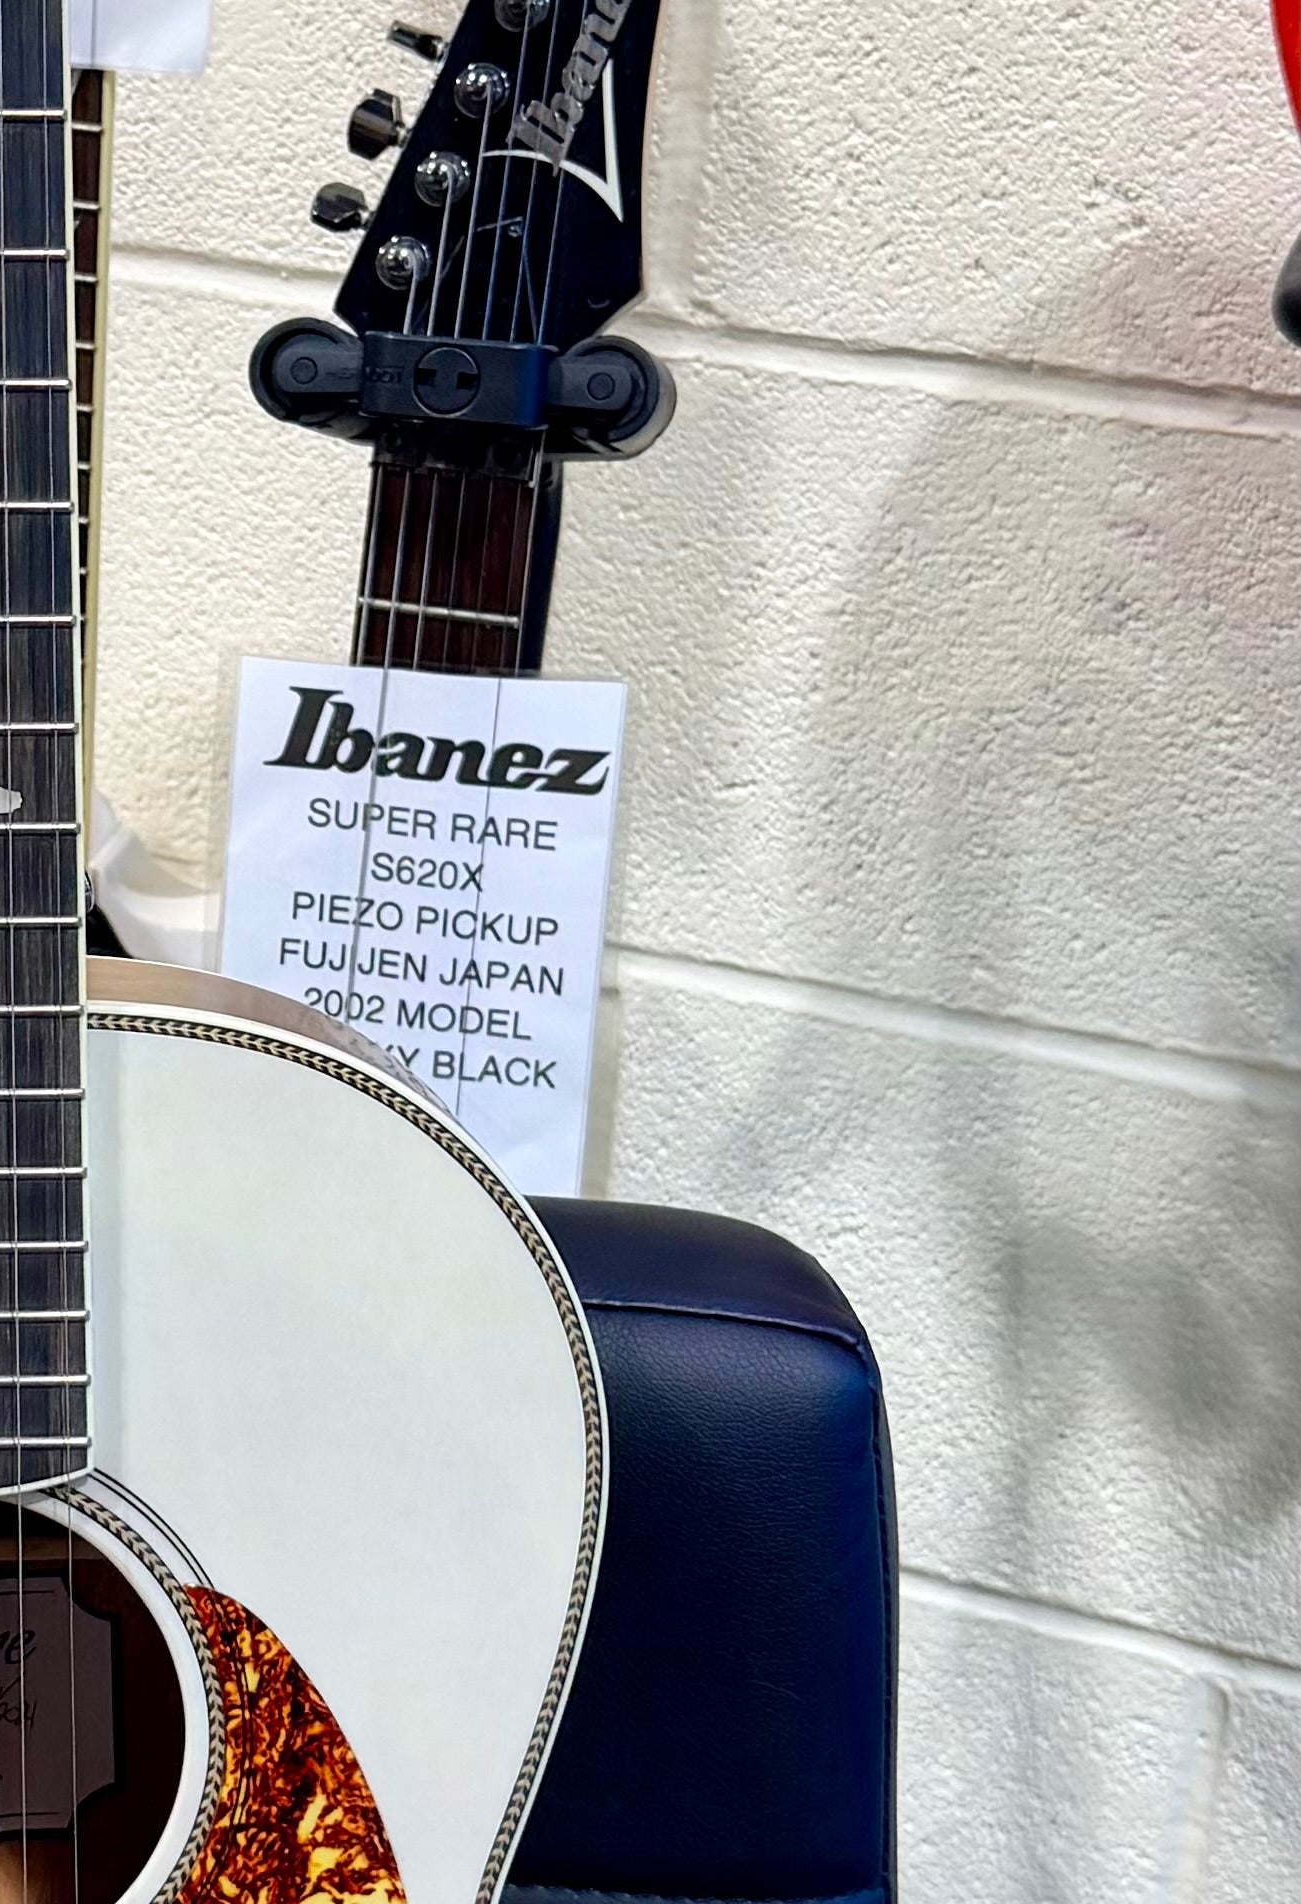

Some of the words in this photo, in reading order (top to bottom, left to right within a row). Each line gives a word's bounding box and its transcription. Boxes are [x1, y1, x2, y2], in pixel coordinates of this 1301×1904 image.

[263, 686, 613, 796] Ibanez
[307, 797, 436, 841] SUPER
[450, 813, 559, 852] RARE
[371, 852, 485, 893] S620X
[292, 891, 404, 931] PIEZO
[415, 907, 560, 947] PICKUP
[439, 959, 565, 996] JAPAN
[304, 987, 385, 1024] 2002
[397, 998, 532, 1041] MODEL
[432, 1049, 558, 1089] BLACK
